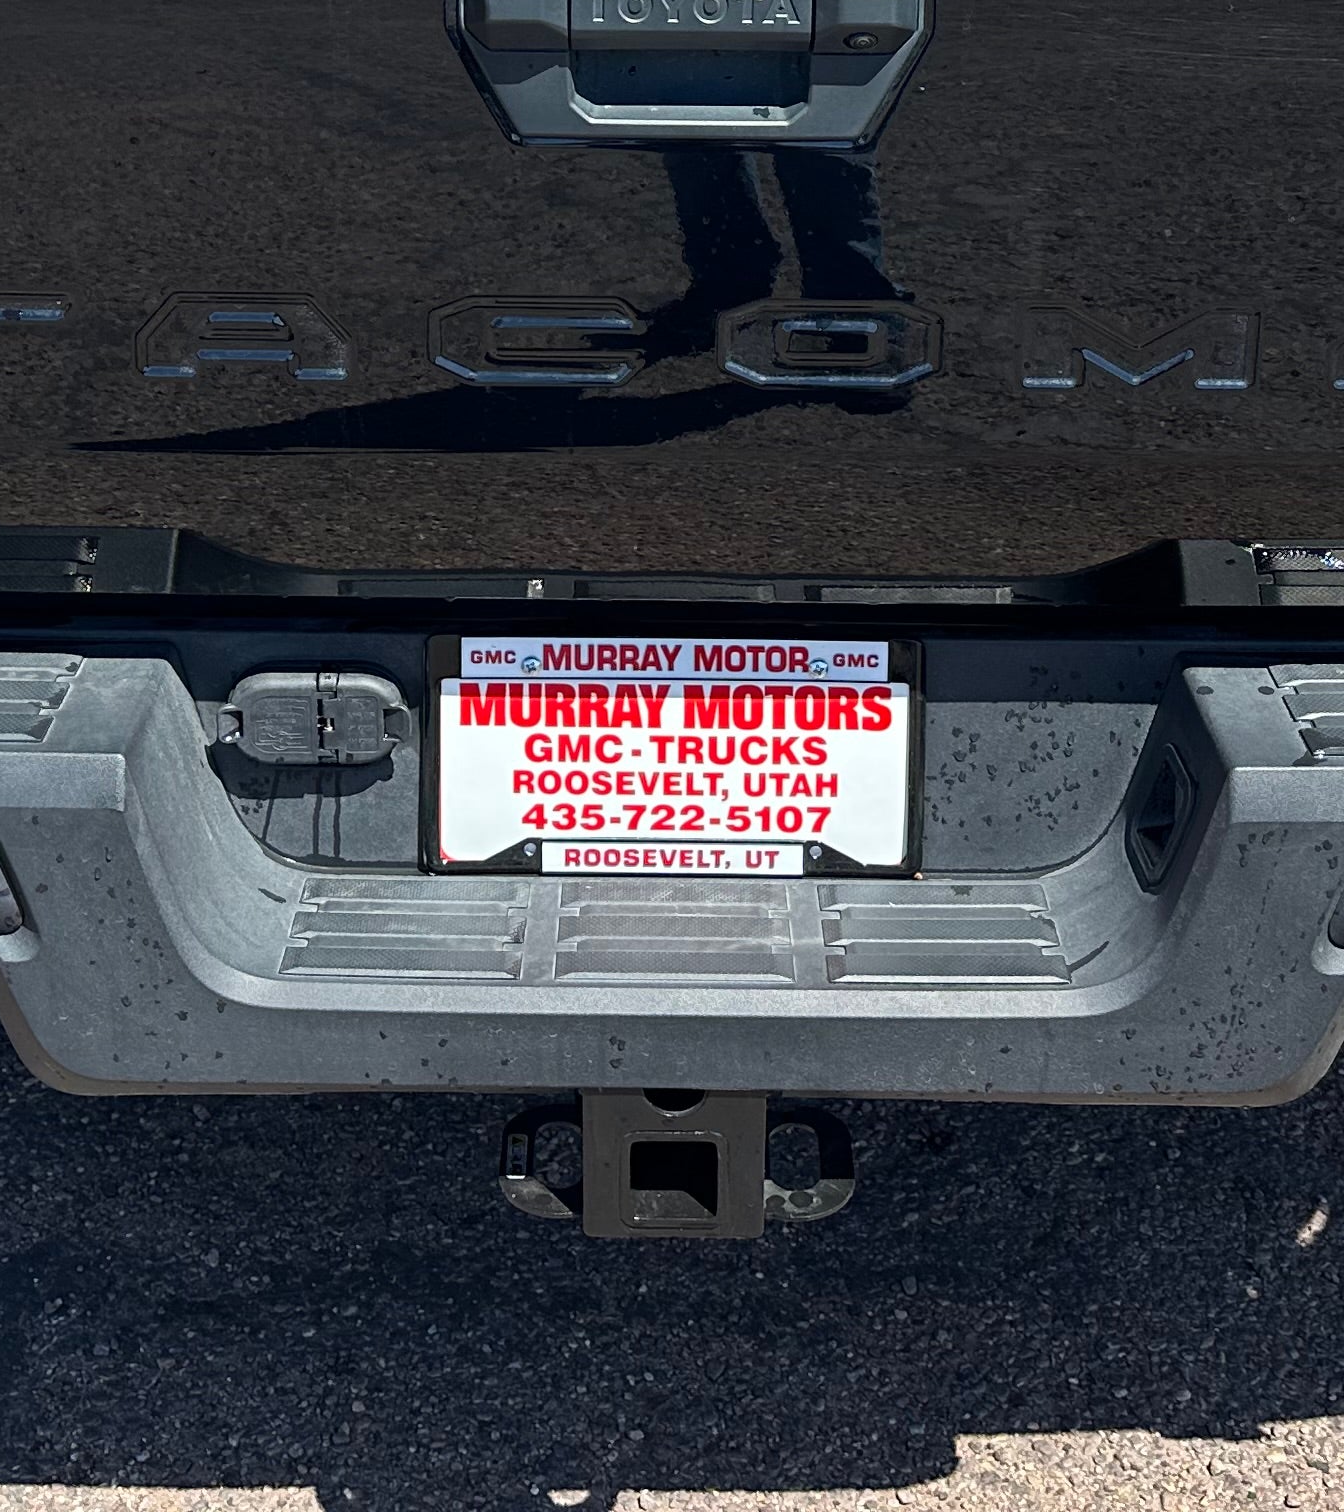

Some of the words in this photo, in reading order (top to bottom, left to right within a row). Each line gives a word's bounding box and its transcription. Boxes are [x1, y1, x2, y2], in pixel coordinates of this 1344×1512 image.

[470, 650, 517, 665] GMC
[542, 643, 682, 672] MURRAY
[693, 644, 810, 673] MOTOR
[832, 653, 880, 668] GMC
[459, 682, 672, 729] MURRAY
[683, 684, 893, 732] MOTORS
[513, 770, 729, 801] ROOSEVELT,
[743, 772, 839, 798] UTAH
[522, 803, 832, 833] 435-722-5107
[564, 848, 731, 870] ROOSEVELT,
[745, 850, 780, 869] UT
